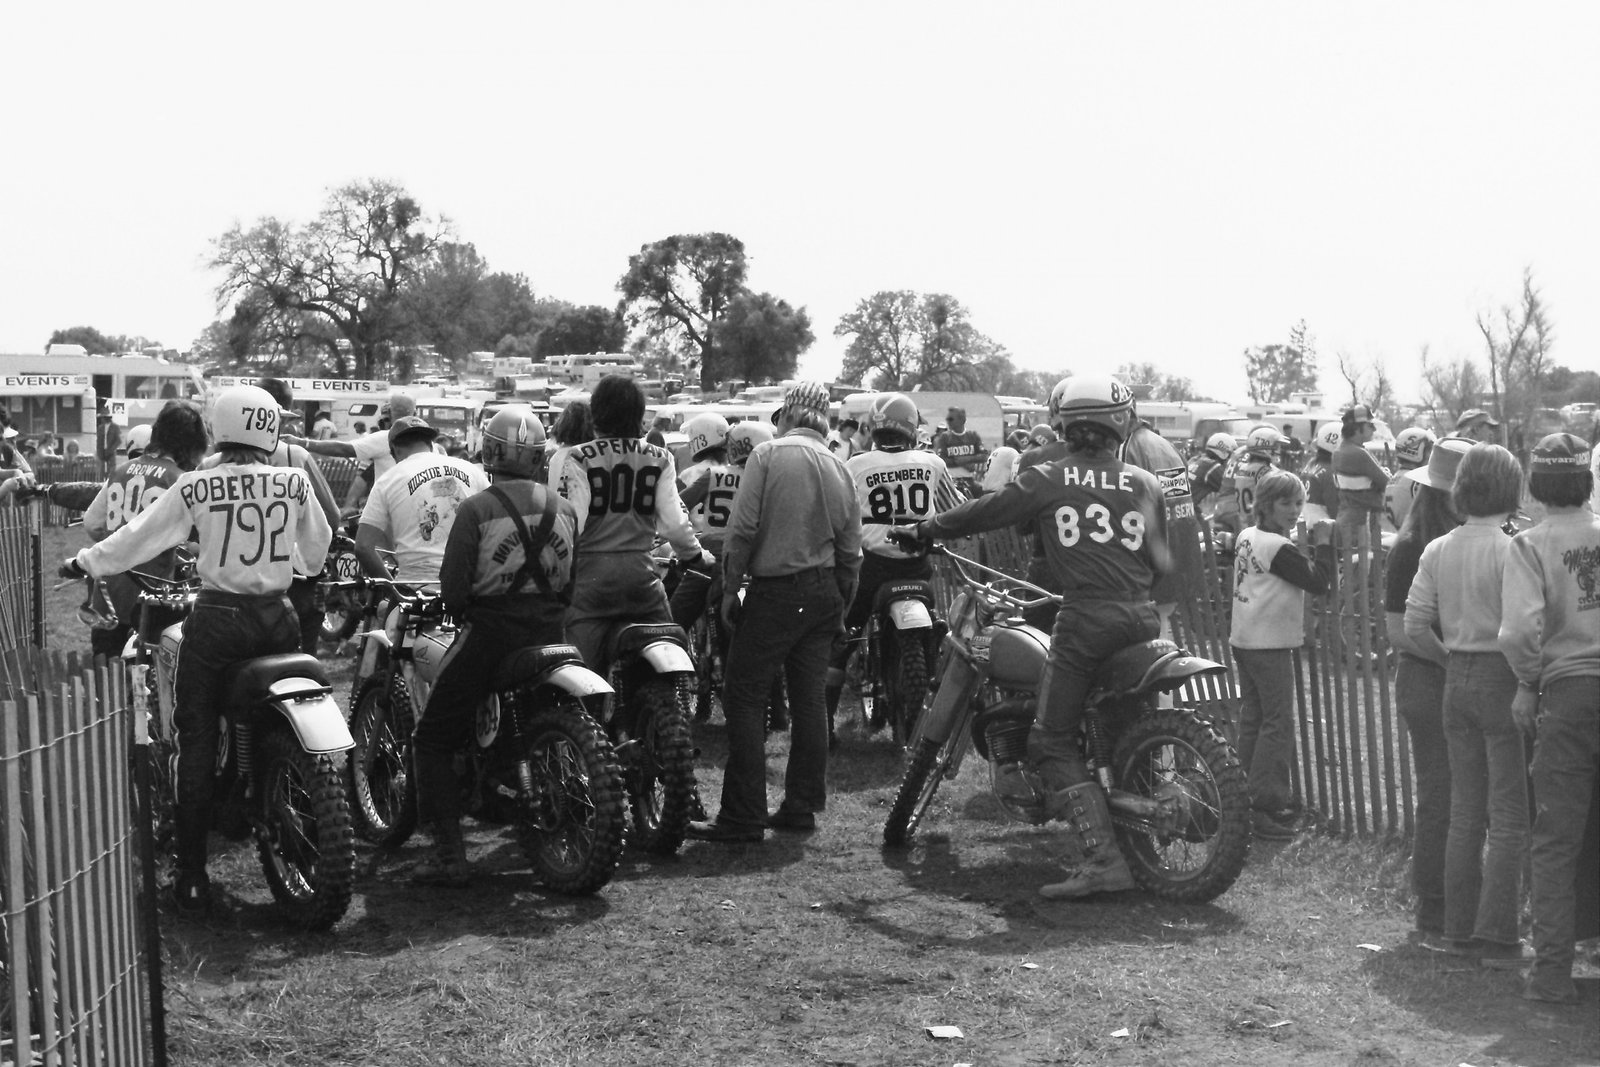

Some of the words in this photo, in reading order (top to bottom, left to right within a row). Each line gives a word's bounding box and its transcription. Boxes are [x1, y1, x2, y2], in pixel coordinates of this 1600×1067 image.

[5, 376, 70, 386] EVENTS
[312, 381, 371, 392] EVENTS
[241, 407, 276, 434] 792
[126, 463, 167, 479] BROWN
[407, 466, 442, 496] HILLSIDE
[865, 468, 932, 488] GREENBERG
[1064, 466, 1134, 493] HALE
[586, 463, 662, 516] 808
[867, 482, 930, 522] 810
[208, 500, 291, 568] 792
[1055, 503, 1145, 551] 839
[891, 584, 923, 593] SUZUKI
[542, 648, 575, 656] HONDA
